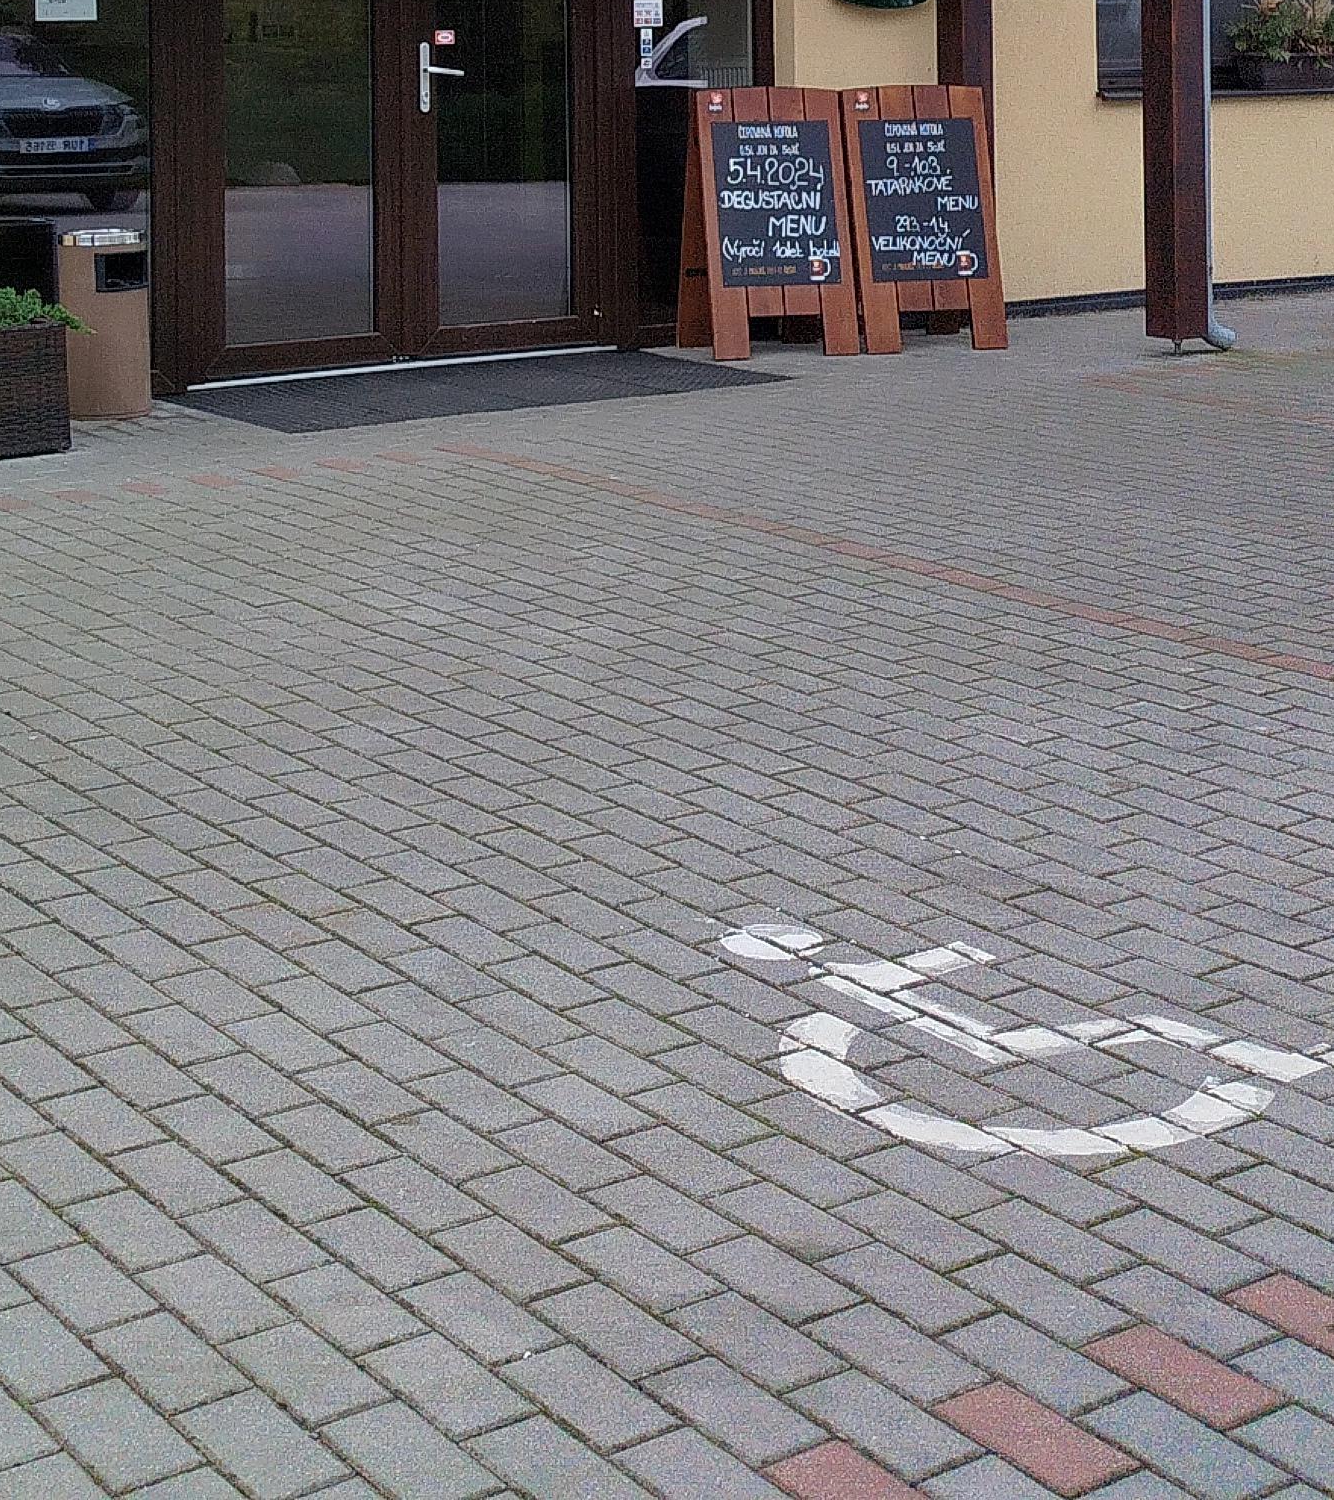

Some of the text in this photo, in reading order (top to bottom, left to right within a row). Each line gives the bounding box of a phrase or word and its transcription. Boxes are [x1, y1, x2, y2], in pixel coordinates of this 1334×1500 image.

[936, 195, 978, 211] MENU
[768, 215, 826, 237] MENU
[871, 229, 971, 251] VELIKONOČNÍ
[912, 251, 956, 267] MENU
